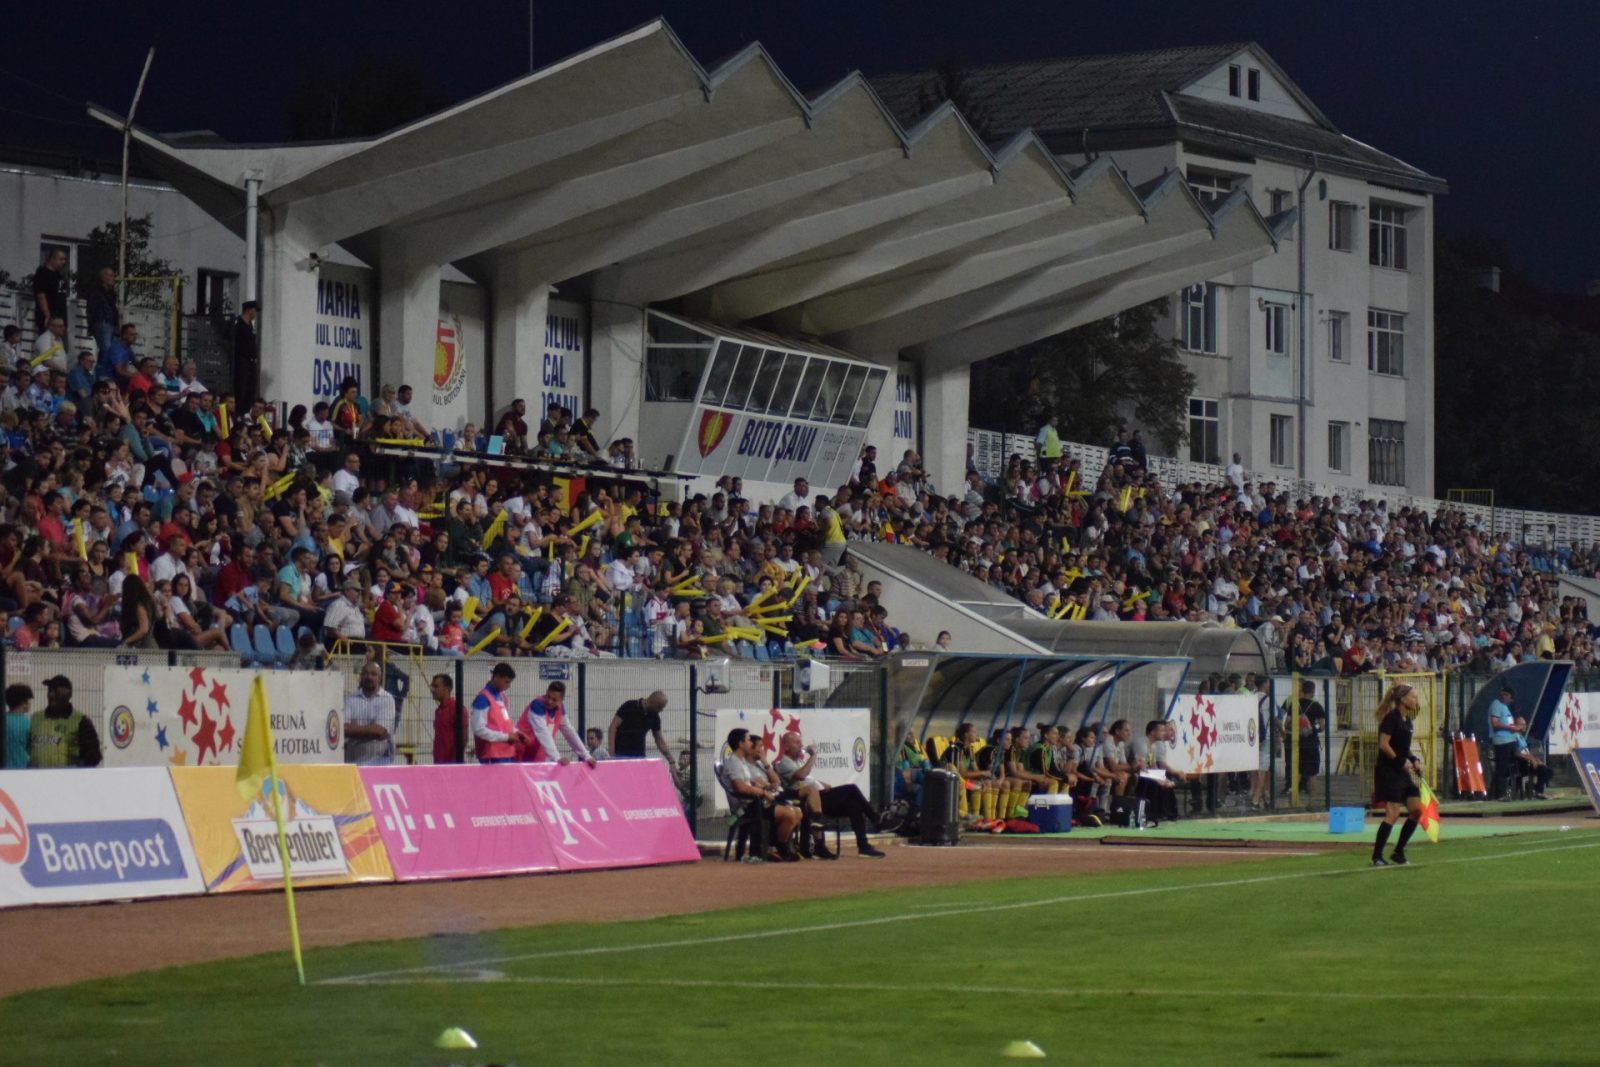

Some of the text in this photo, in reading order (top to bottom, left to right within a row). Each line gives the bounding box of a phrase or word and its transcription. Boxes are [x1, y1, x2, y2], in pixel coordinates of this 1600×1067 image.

[334, 327, 362, 350] LOCAL
[543, 353, 566, 388] CAL
[894, 410, 912, 439] ANI
[282, 738, 322, 755] FOTBAL
[372, 784, 419, 853] T
[534, 780, 579, 845] T
[37, 831, 170, 880] Bancpost
